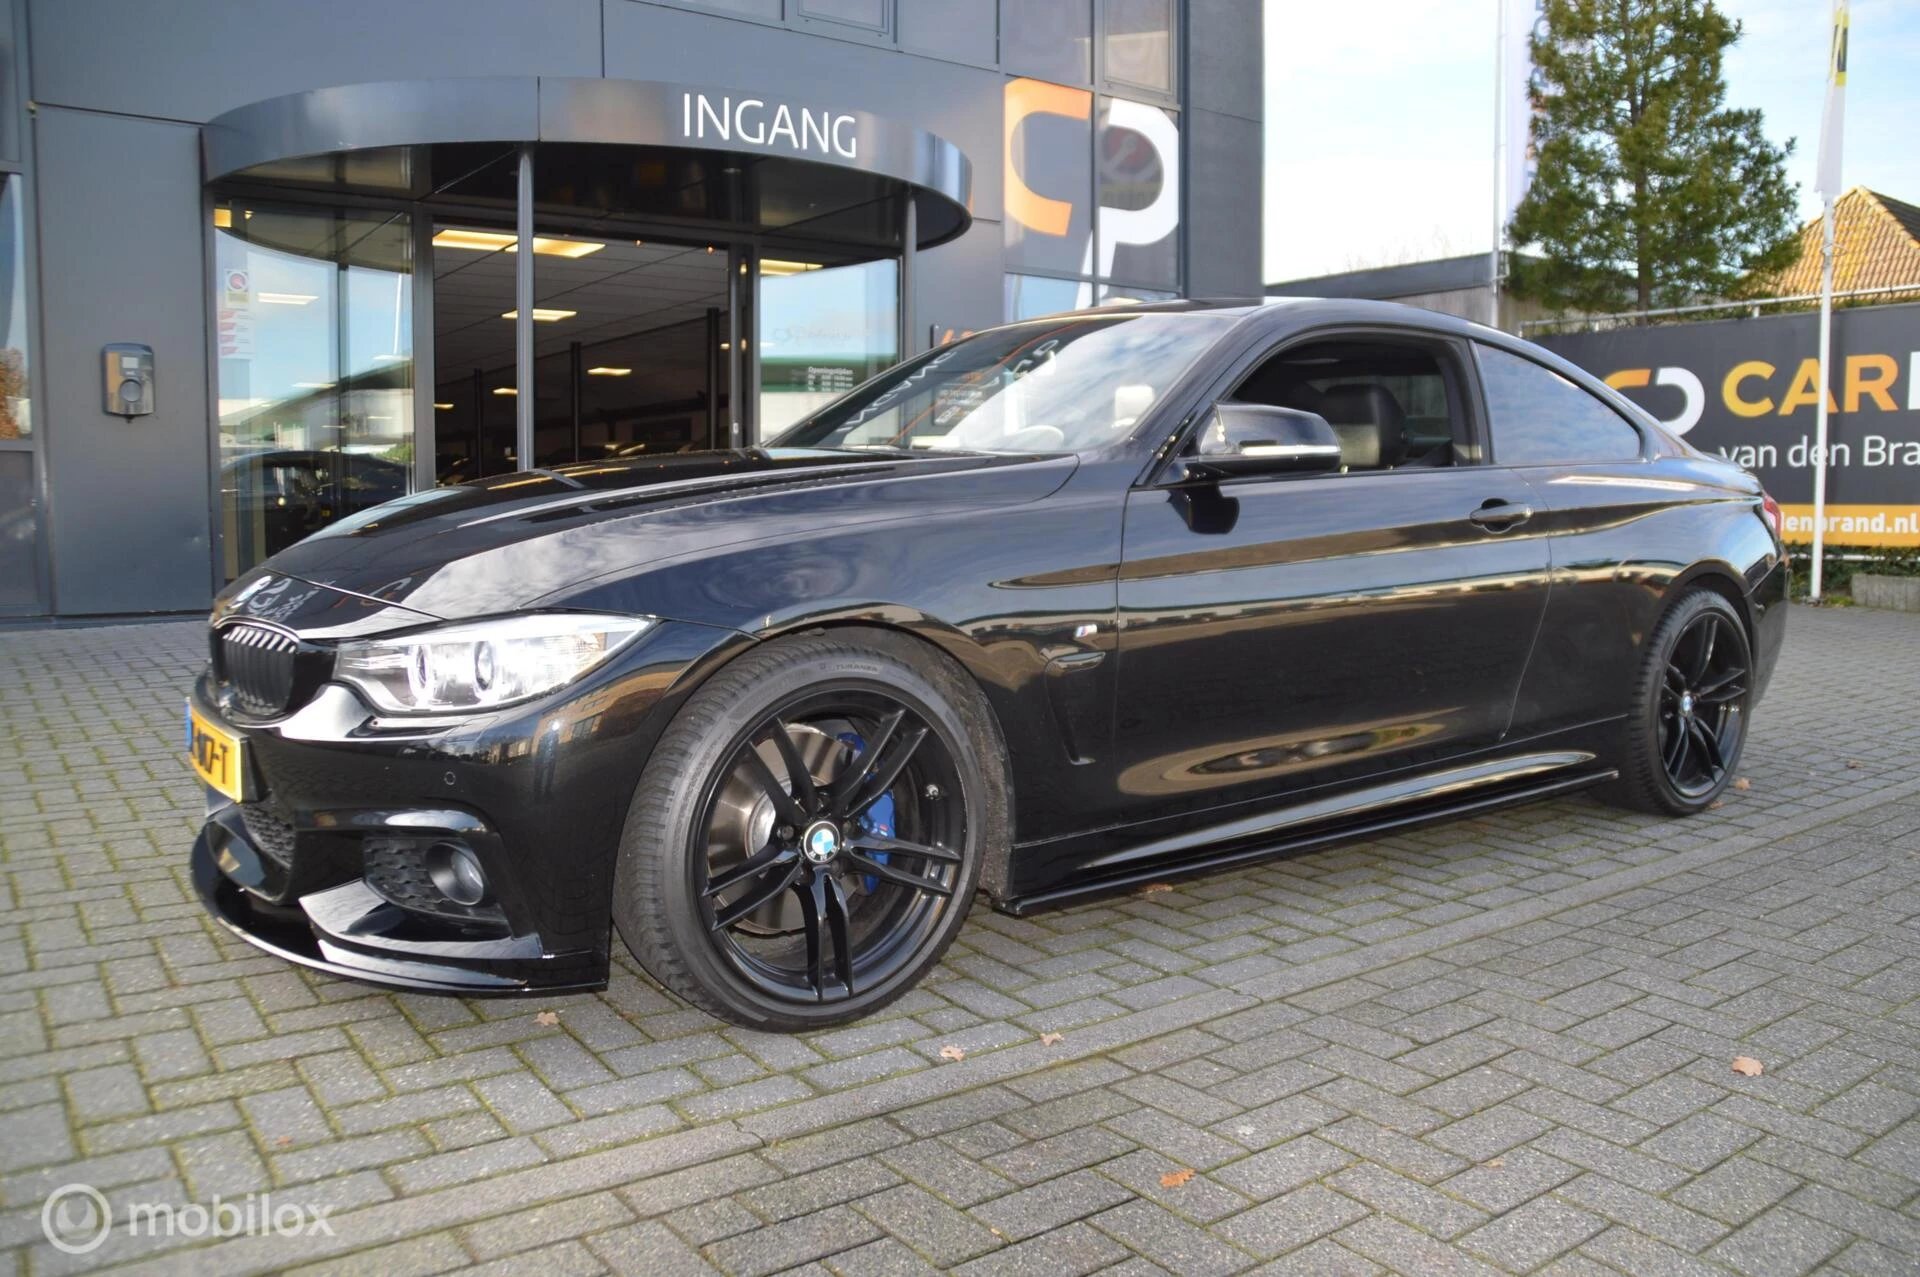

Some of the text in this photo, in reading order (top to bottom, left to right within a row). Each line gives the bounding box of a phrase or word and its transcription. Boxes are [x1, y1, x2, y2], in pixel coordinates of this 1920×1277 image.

[683, 92, 857, 158] INGANG
[1722, 351, 1920, 417] CAR
[1719, 445, 1777, 468] van
